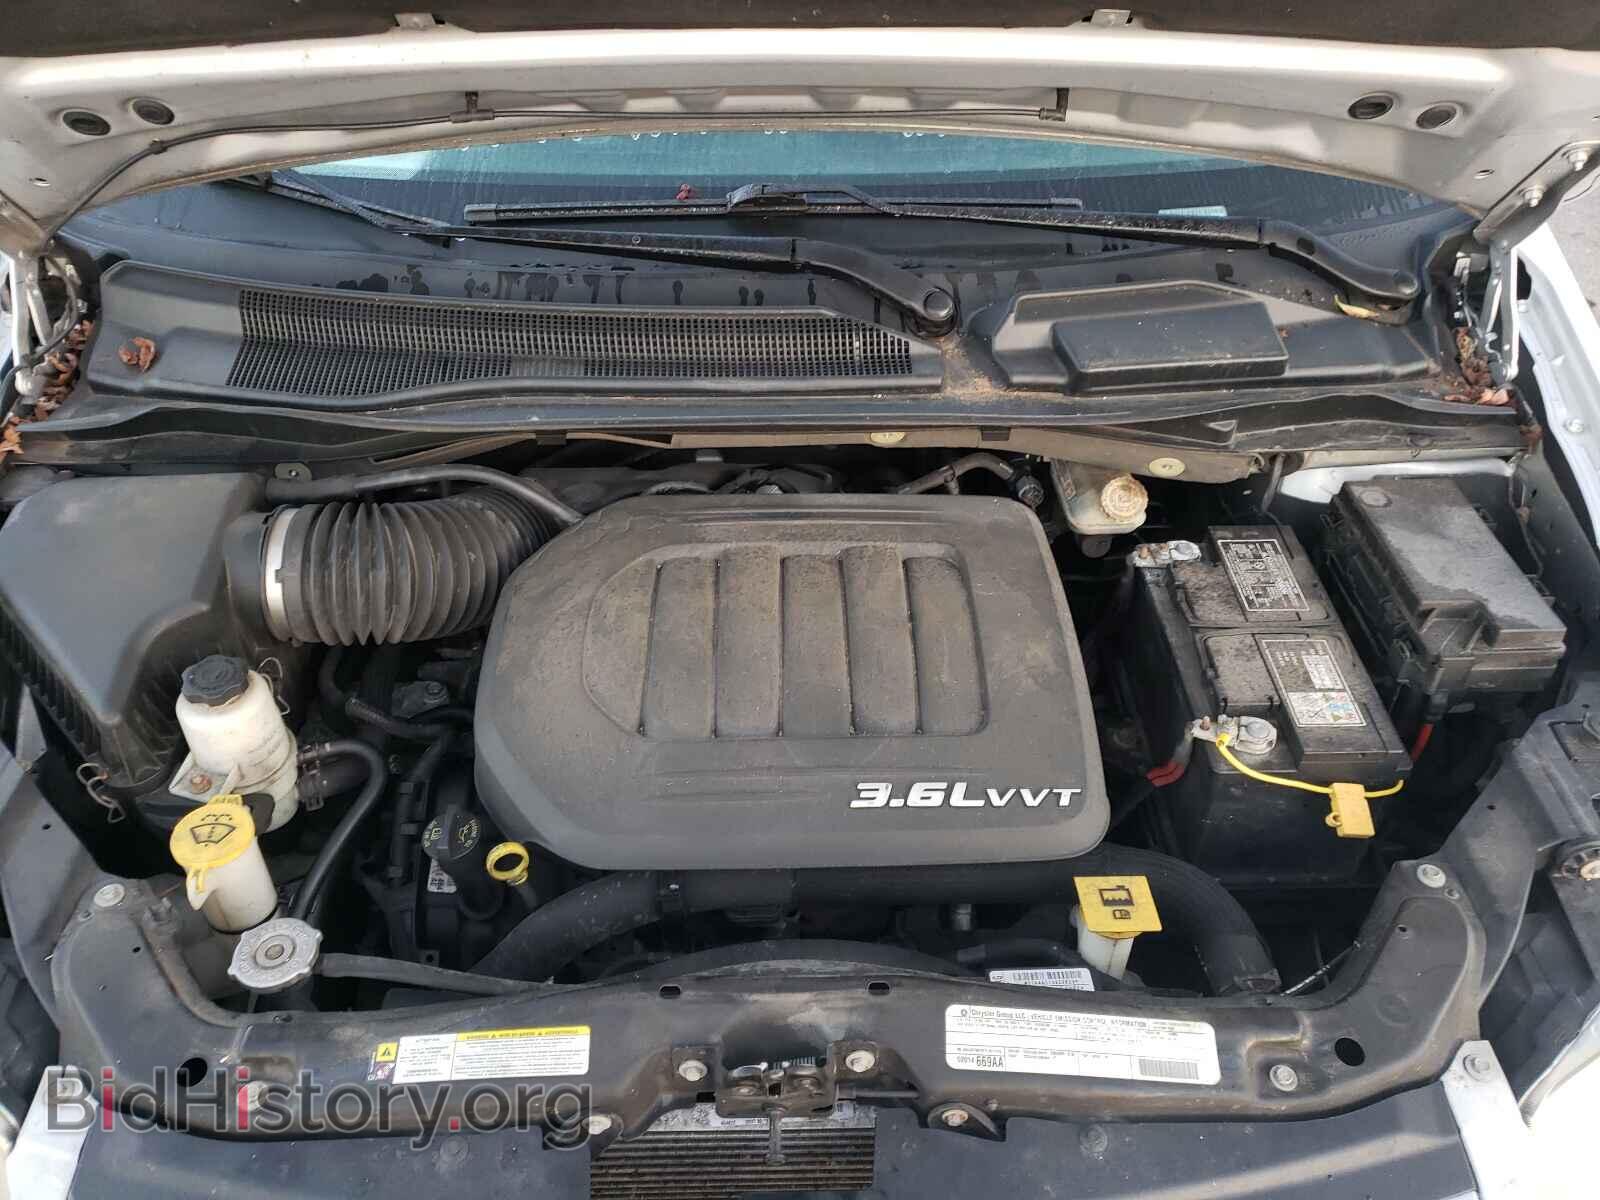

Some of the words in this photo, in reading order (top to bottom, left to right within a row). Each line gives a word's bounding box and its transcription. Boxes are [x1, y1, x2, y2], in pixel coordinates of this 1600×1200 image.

[850, 782, 985, 809] 3.6L
[986, 788, 1082, 808] VVT
[971, 1009, 995, 1018] Chrysler
